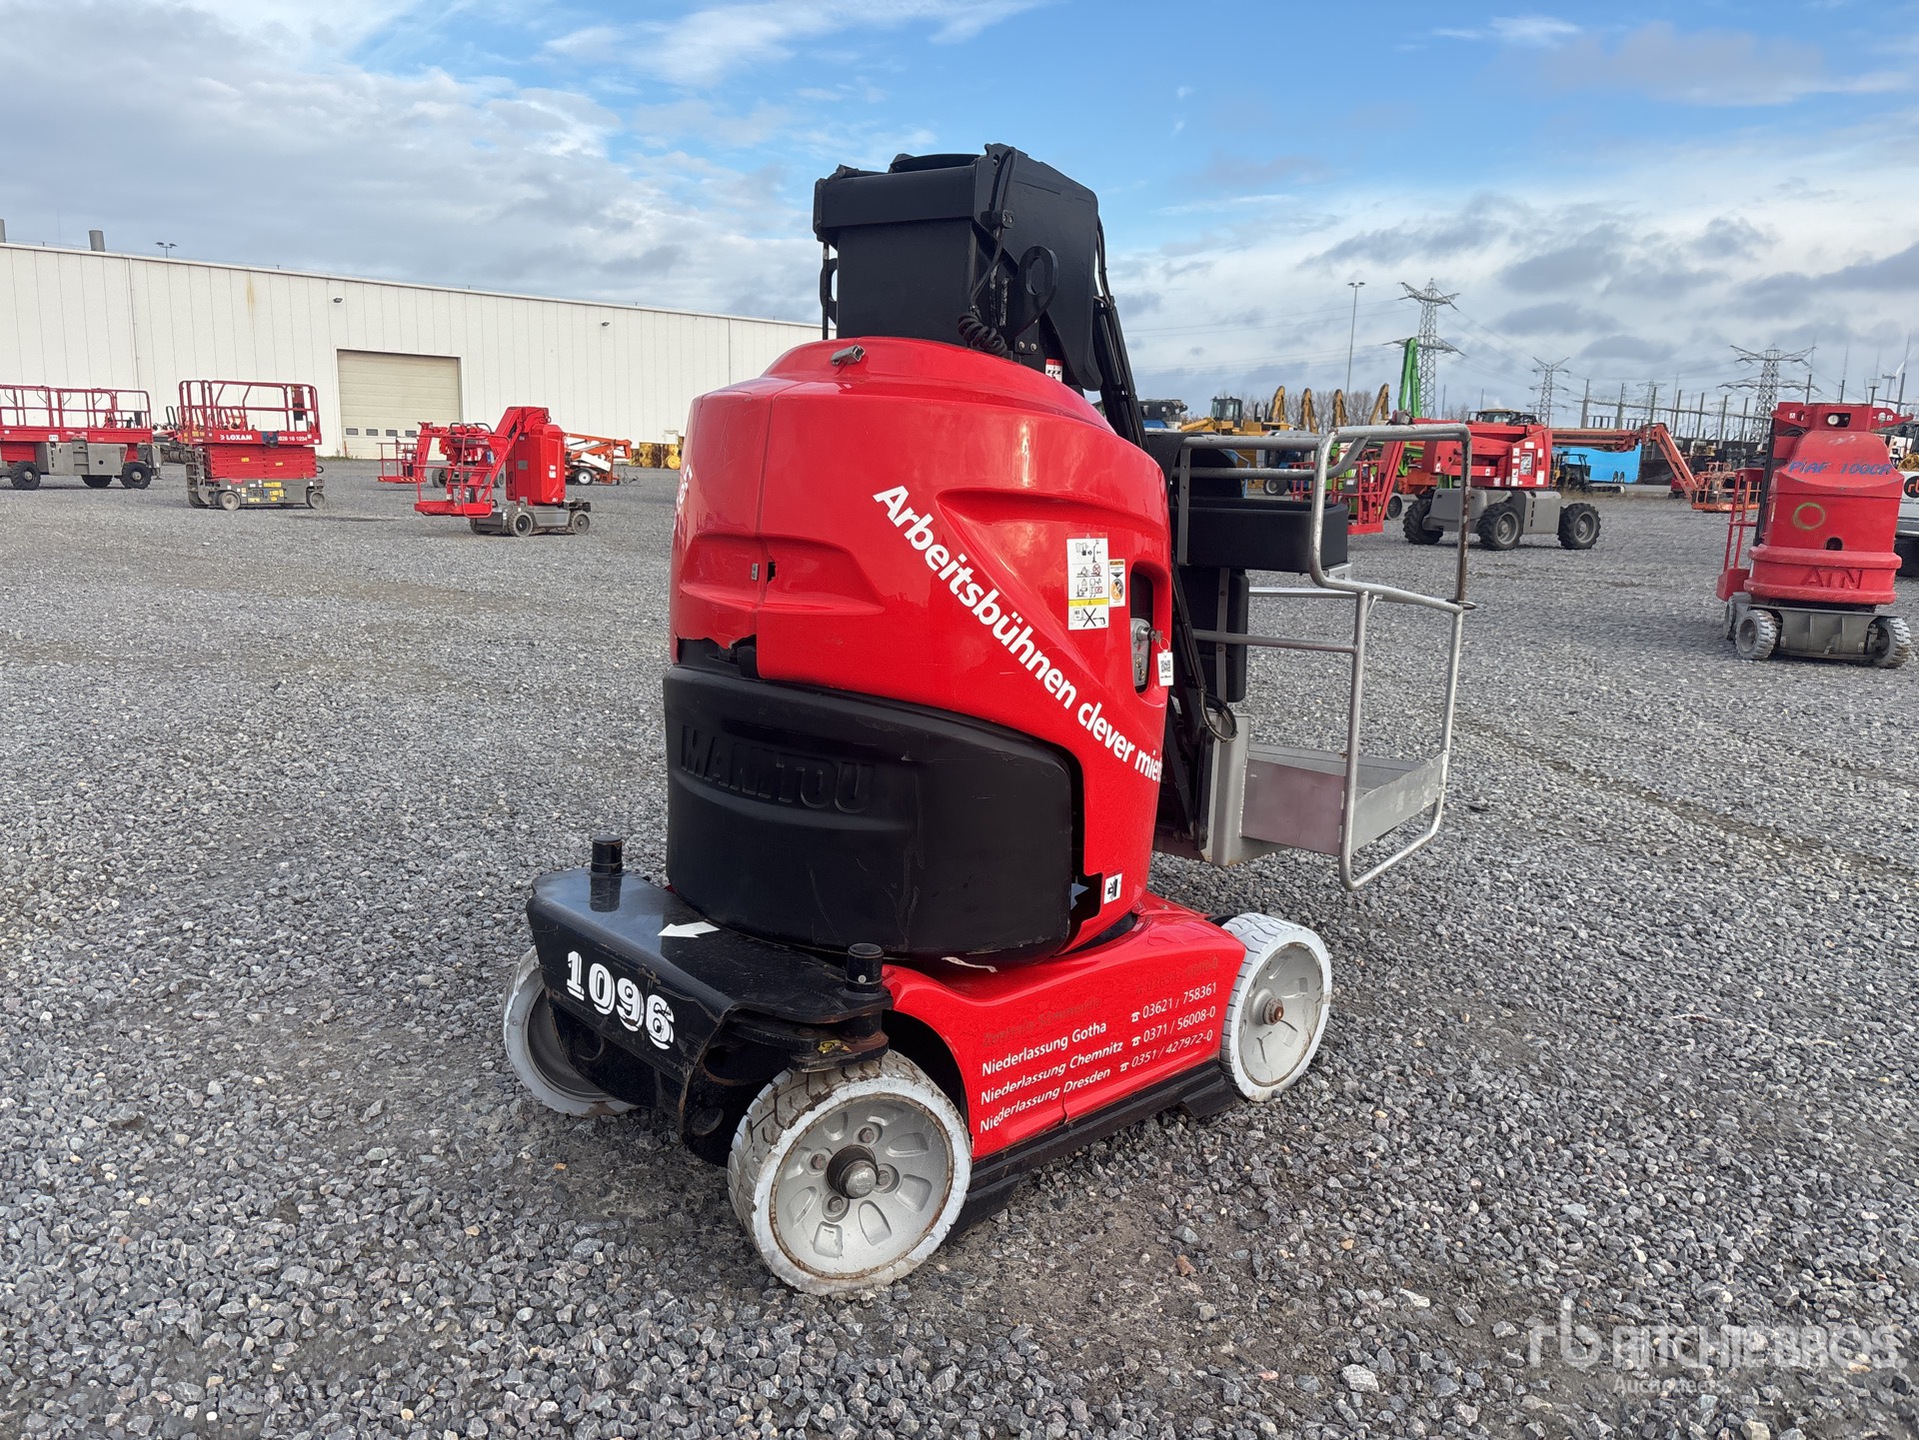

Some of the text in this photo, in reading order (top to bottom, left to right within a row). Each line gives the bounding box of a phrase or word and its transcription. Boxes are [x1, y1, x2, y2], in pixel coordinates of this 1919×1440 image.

[872, 485, 1077, 710] Arbeitsbühnen
[1077, 701, 1135, 763] clever
[1800, 568, 1864, 590] ATN
[566, 951, 675, 1050] 1096
[982, 1036, 1069, 1077] Niederlassung
[1071, 1022, 1107, 1043] Gotha
[1142, 997, 1173, 1019] 03621
[1183, 981, 1217, 1005] 758361
[980, 1086, 1061, 1134] Niederlassung
[1063, 1067, 1111, 1094] Dresden
[1131, 1048, 1157, 1068] 0351
[1165, 1029, 1213, 1054] 427972-0
[981, 1063, 1067, 1106] Niederlassung
[1069, 1041, 1124, 1069] Chemnitz
[1143, 1023, 1168, 1043] 0371
[1176, 1005, 1216, 1031] 56008-0
